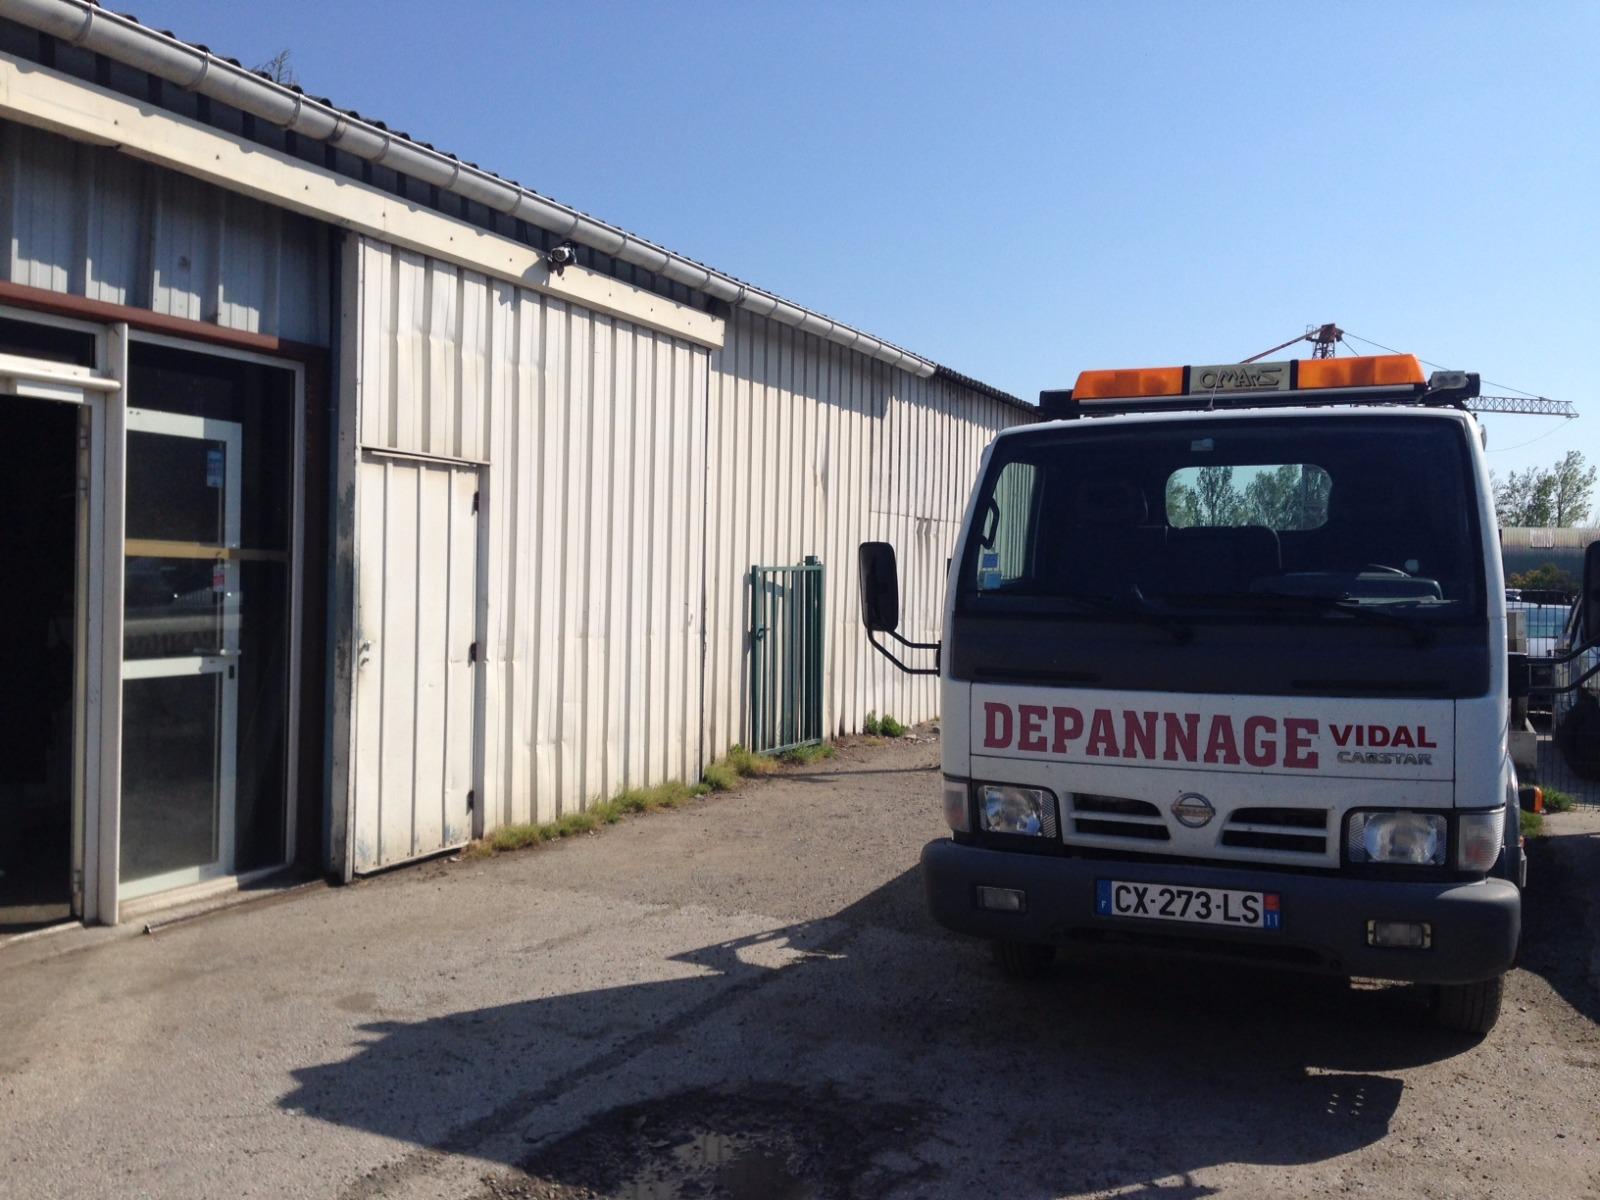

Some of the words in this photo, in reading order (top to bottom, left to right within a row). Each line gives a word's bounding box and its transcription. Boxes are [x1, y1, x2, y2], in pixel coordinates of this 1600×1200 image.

[983, 701, 1319, 769] DEPANNAGE
[1328, 724, 1437, 748] VIDAL
[1337, 751, 1433, 765] CABSTAR
[1115, 884, 1260, 924] CX-273-LS
[1266, 913, 1279, 927] 11
